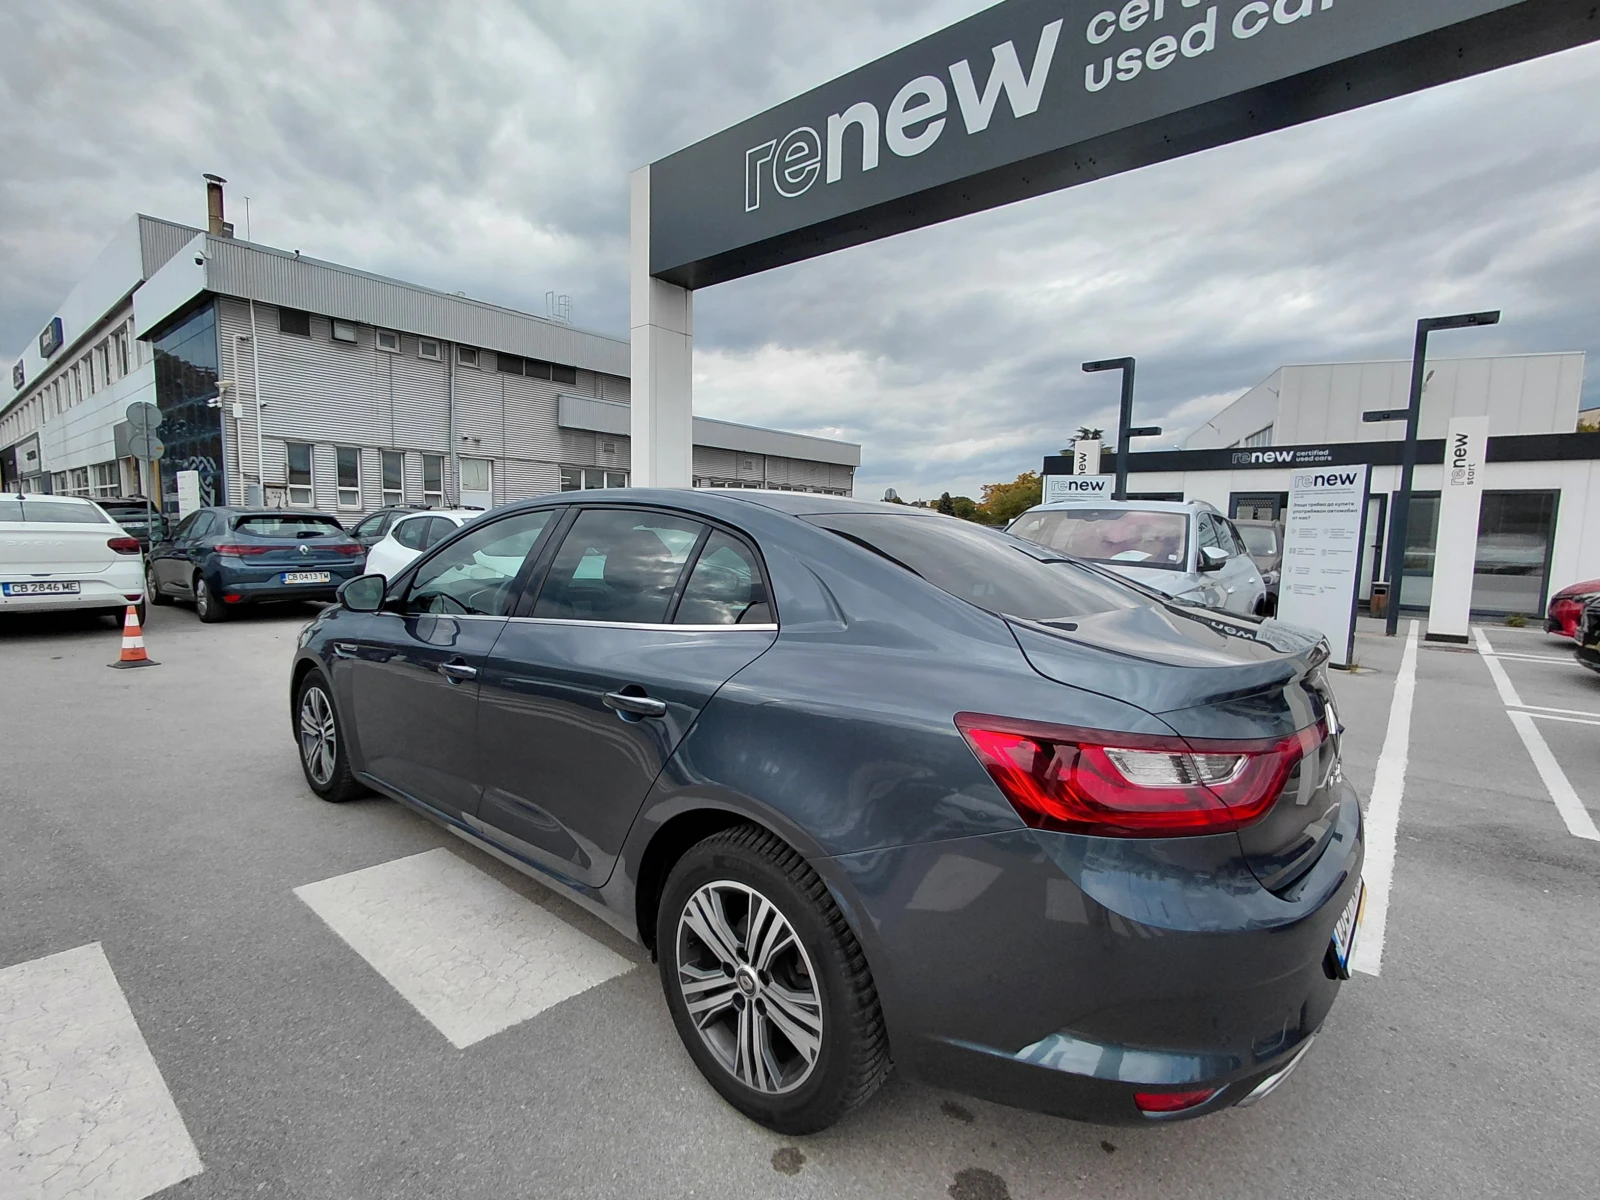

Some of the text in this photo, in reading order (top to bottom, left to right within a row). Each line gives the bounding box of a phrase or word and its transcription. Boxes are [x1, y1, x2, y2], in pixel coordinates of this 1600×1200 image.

[1086, 0, 1201, 44] cer
[1085, 6, 1217, 92] used
[745, 18, 1063, 213] renew
[1232, 450, 1294, 464] renew
[1451, 433, 1468, 485] renew
[1294, 472, 1358, 488] renew
[1467, 463, 1475, 485] start
[1051, 480, 1105, 491] renew
[288, 573, 298, 581] CB
[12, 583, 77, 593] CB 2846 ME
